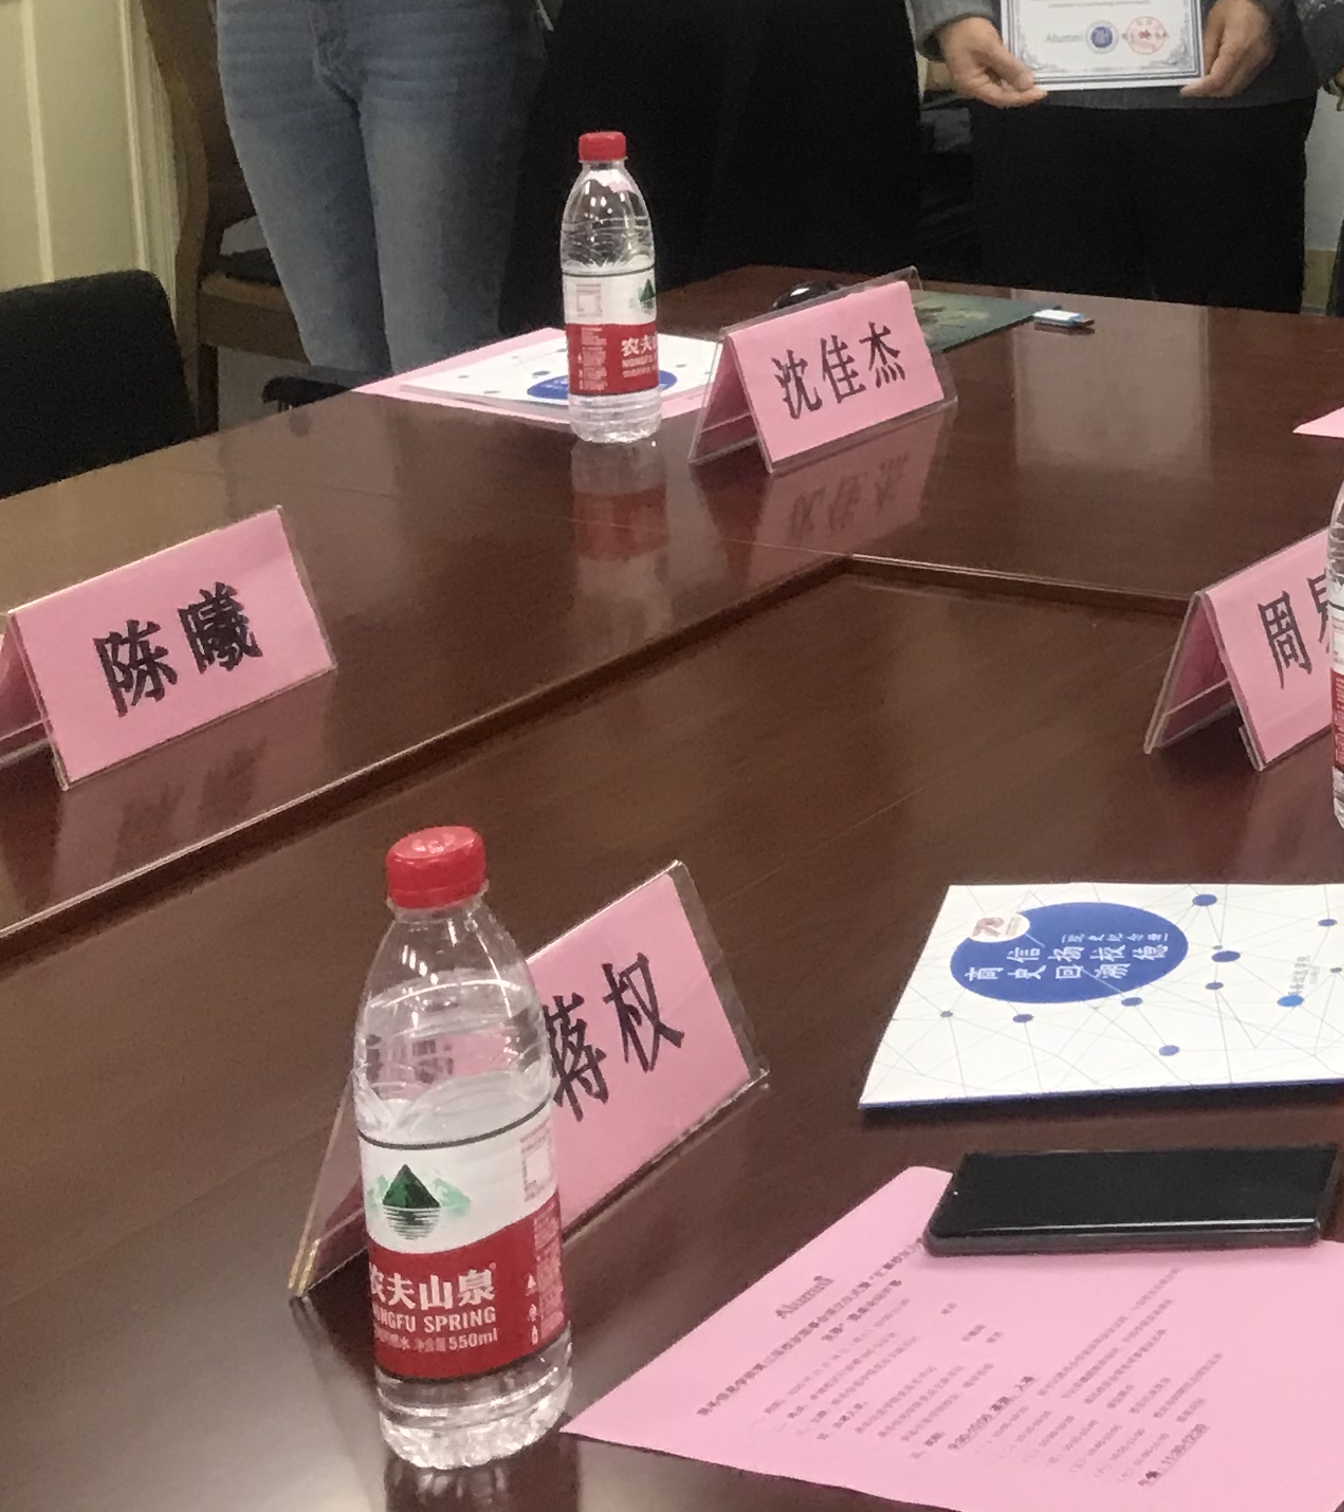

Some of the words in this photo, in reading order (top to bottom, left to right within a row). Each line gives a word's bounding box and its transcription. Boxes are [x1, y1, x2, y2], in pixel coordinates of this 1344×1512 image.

[771, 320, 907, 421] 沈佳杰
[1006, 944, 1169, 963] 信扬校德
[964, 963, 1132, 981] 商史回溯
[542, 952, 685, 1122] 蒋权
[424, 1306, 496, 1333] SPRING
